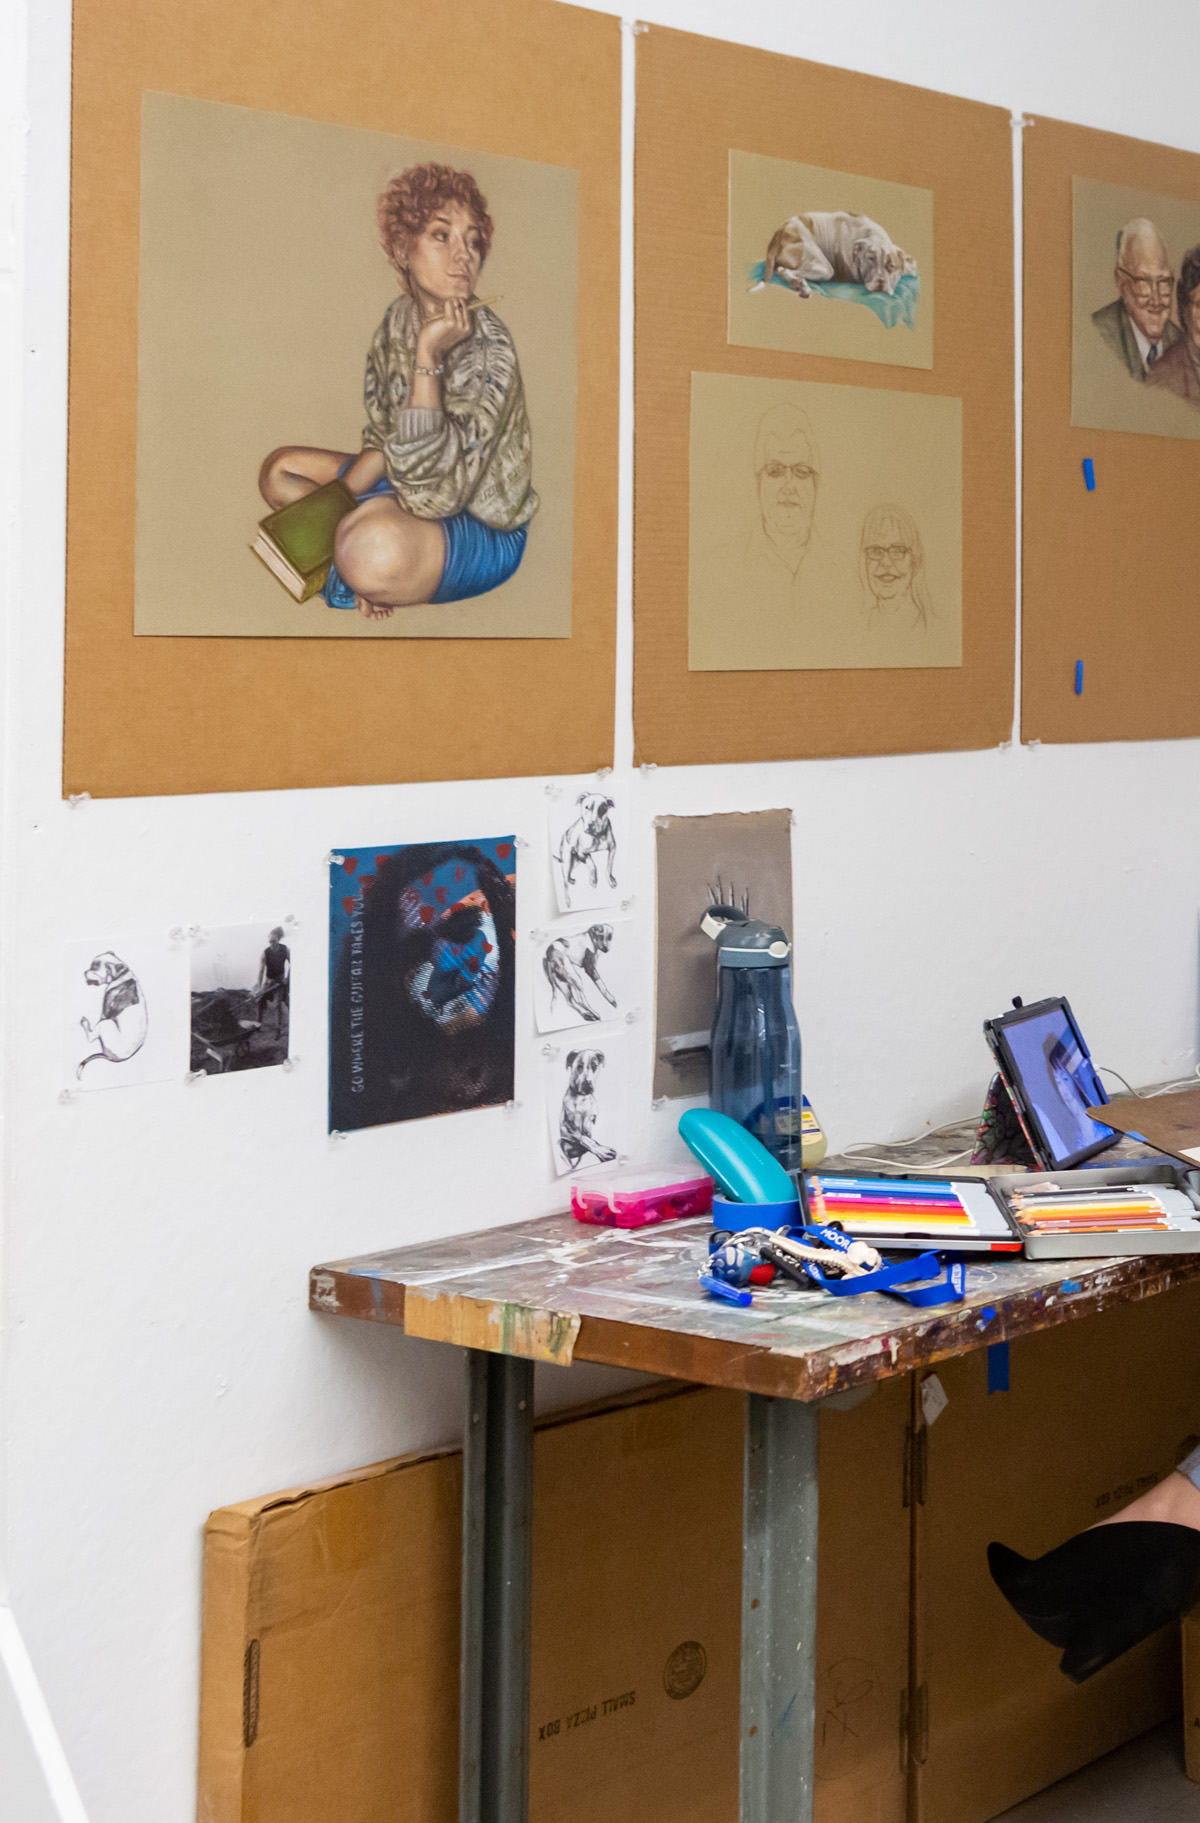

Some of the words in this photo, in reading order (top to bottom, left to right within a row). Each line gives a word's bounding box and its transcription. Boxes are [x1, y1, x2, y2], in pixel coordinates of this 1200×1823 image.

[350, 920, 365, 955] TAKES
[350, 1007, 364, 1029] THE
[350, 1030, 365, 1073] WHERE
[351, 1076, 365, 1093] GO
[601, 1690, 636, 1716] SMALL
[538, 1719, 561, 1742] BOX
